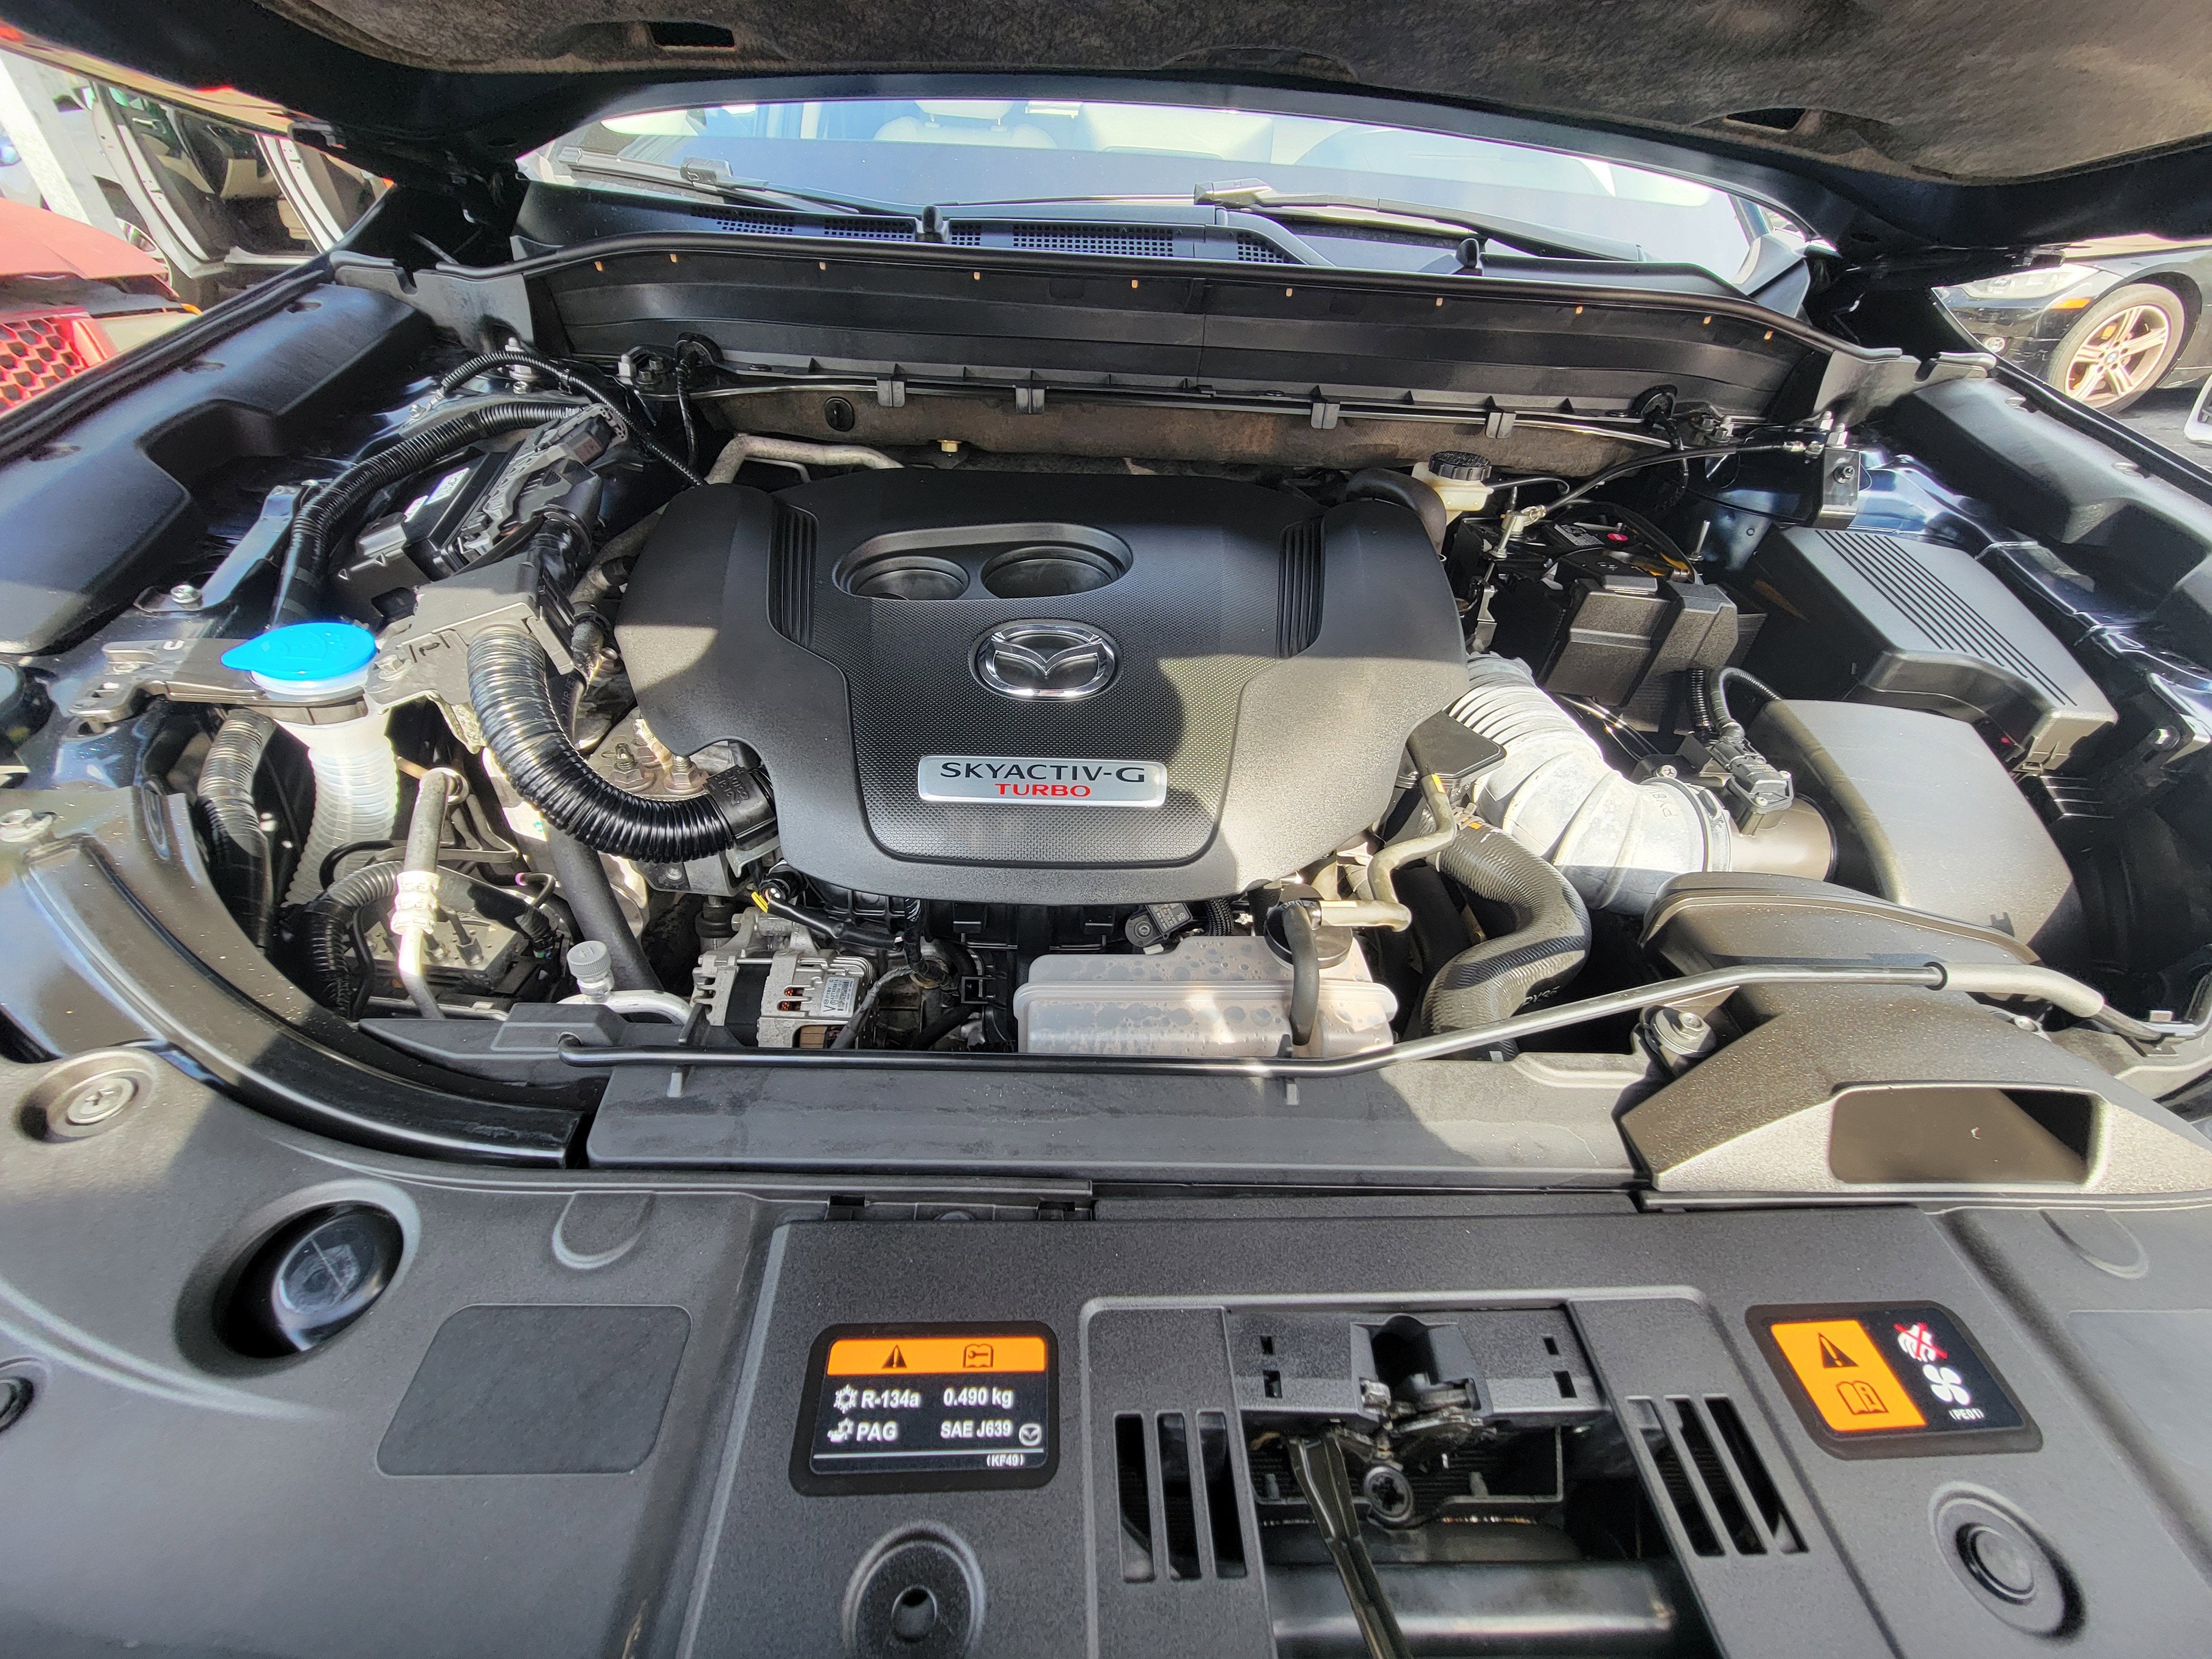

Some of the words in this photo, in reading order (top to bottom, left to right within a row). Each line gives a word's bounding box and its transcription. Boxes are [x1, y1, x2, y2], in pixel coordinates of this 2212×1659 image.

[940, 761, 1145, 783] SKYACTIV-G
[994, 783, 1091, 797] TURBO
[579, 947, 595, 958] H
[861, 1388, 921, 1409] R-134a
[943, 1387, 988, 1407] 0.490
[991, 1386, 1014, 1409] kg
[1949, 1408, 1984, 1420] (PE01)
[856, 1420, 898, 1442] PAG
[940, 1420, 973, 1438] SAE
[976, 1420, 1012, 1438] J639
[986, 1454, 1024, 1468] (KF49)
